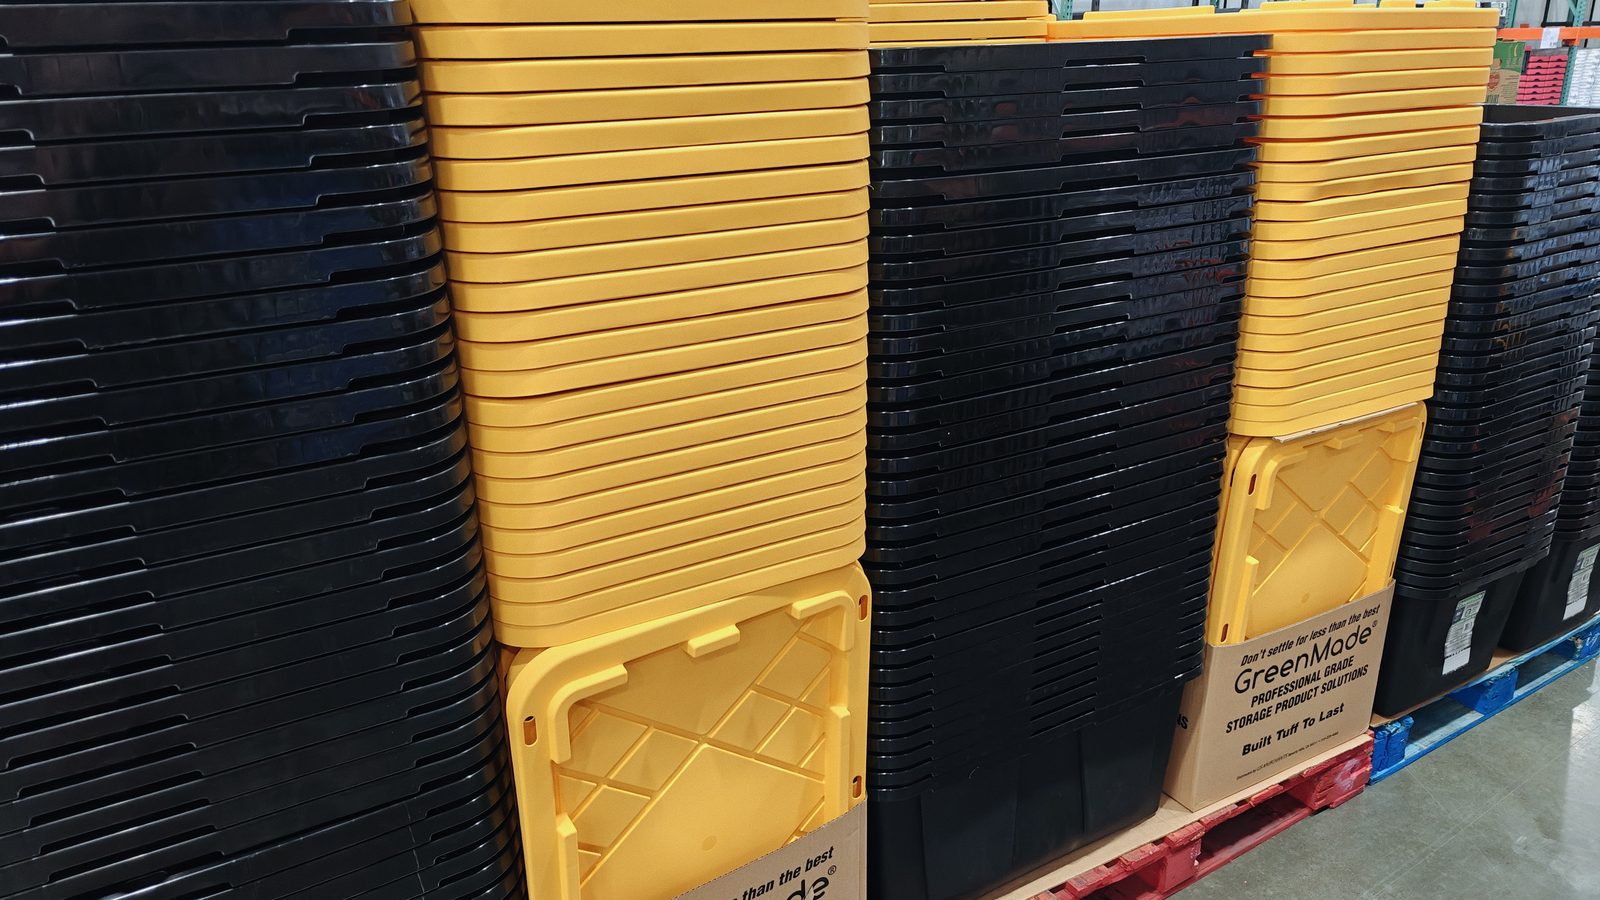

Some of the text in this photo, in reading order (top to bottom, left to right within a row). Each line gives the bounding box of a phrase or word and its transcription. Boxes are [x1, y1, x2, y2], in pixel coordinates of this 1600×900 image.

[1240, 604, 1381, 667] Don't settle for less than the best
[1225, 664, 1369, 734] STORAGE PRODUCT SOLUTIONS
[1250, 655, 1355, 708] PROFESSIONAL GRADE
[1241, 702, 1345, 756] Built Tuff To Last
[742, 846, 834, 900] than the best
